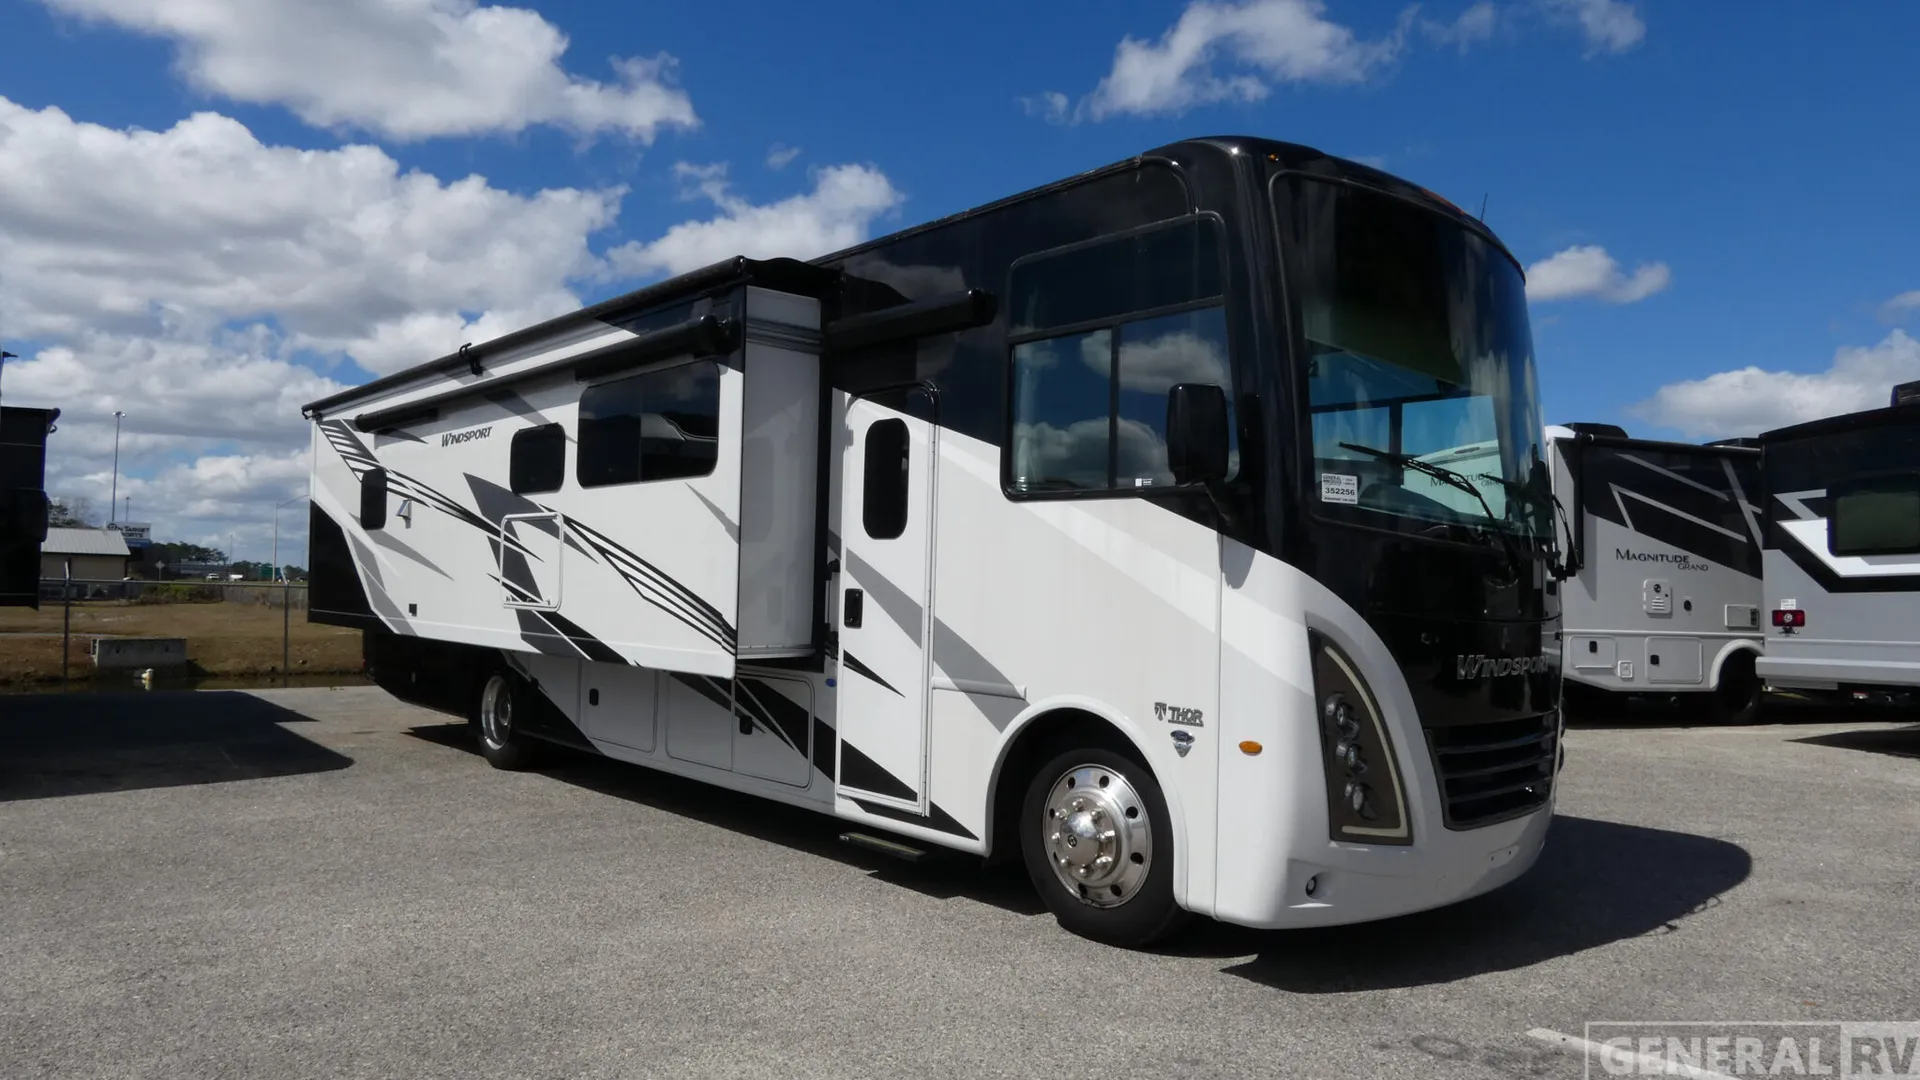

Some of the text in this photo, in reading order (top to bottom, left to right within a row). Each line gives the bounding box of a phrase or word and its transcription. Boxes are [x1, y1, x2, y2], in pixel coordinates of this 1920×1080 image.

[442, 426, 492, 447] WINDSPORT
[1324, 487, 1355, 496] 352256
[1616, 548, 1689, 563] MAGNITUDE
[1677, 563, 1709, 571] GRAND
[1457, 655, 1549, 680] WINDSPORT
[1168, 706, 1203, 724] THOR
